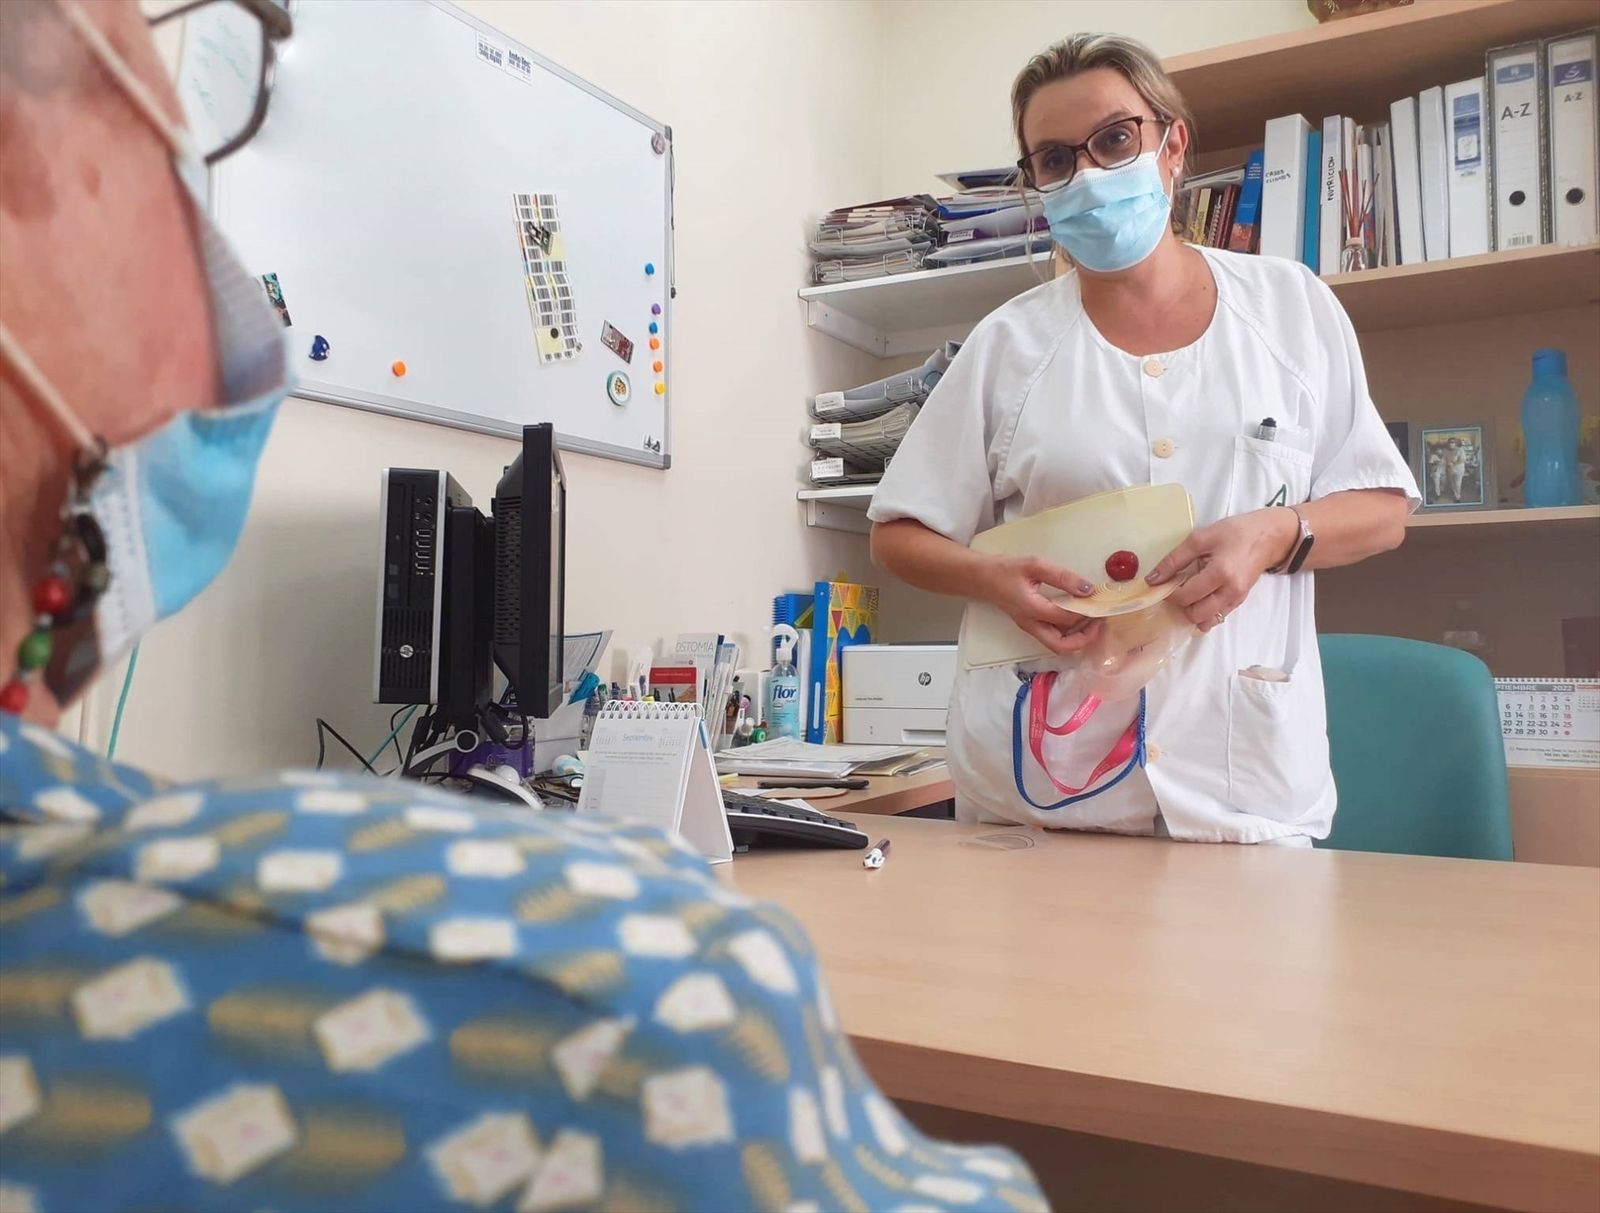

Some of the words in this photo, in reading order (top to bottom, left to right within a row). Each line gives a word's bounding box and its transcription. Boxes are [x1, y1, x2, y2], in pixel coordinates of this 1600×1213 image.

[1563, 91, 1583, 102] A-Z
[1501, 102, 1532, 120] A-Z
[918, 671, 932, 687] hp
[772, 684, 797, 702] flor
